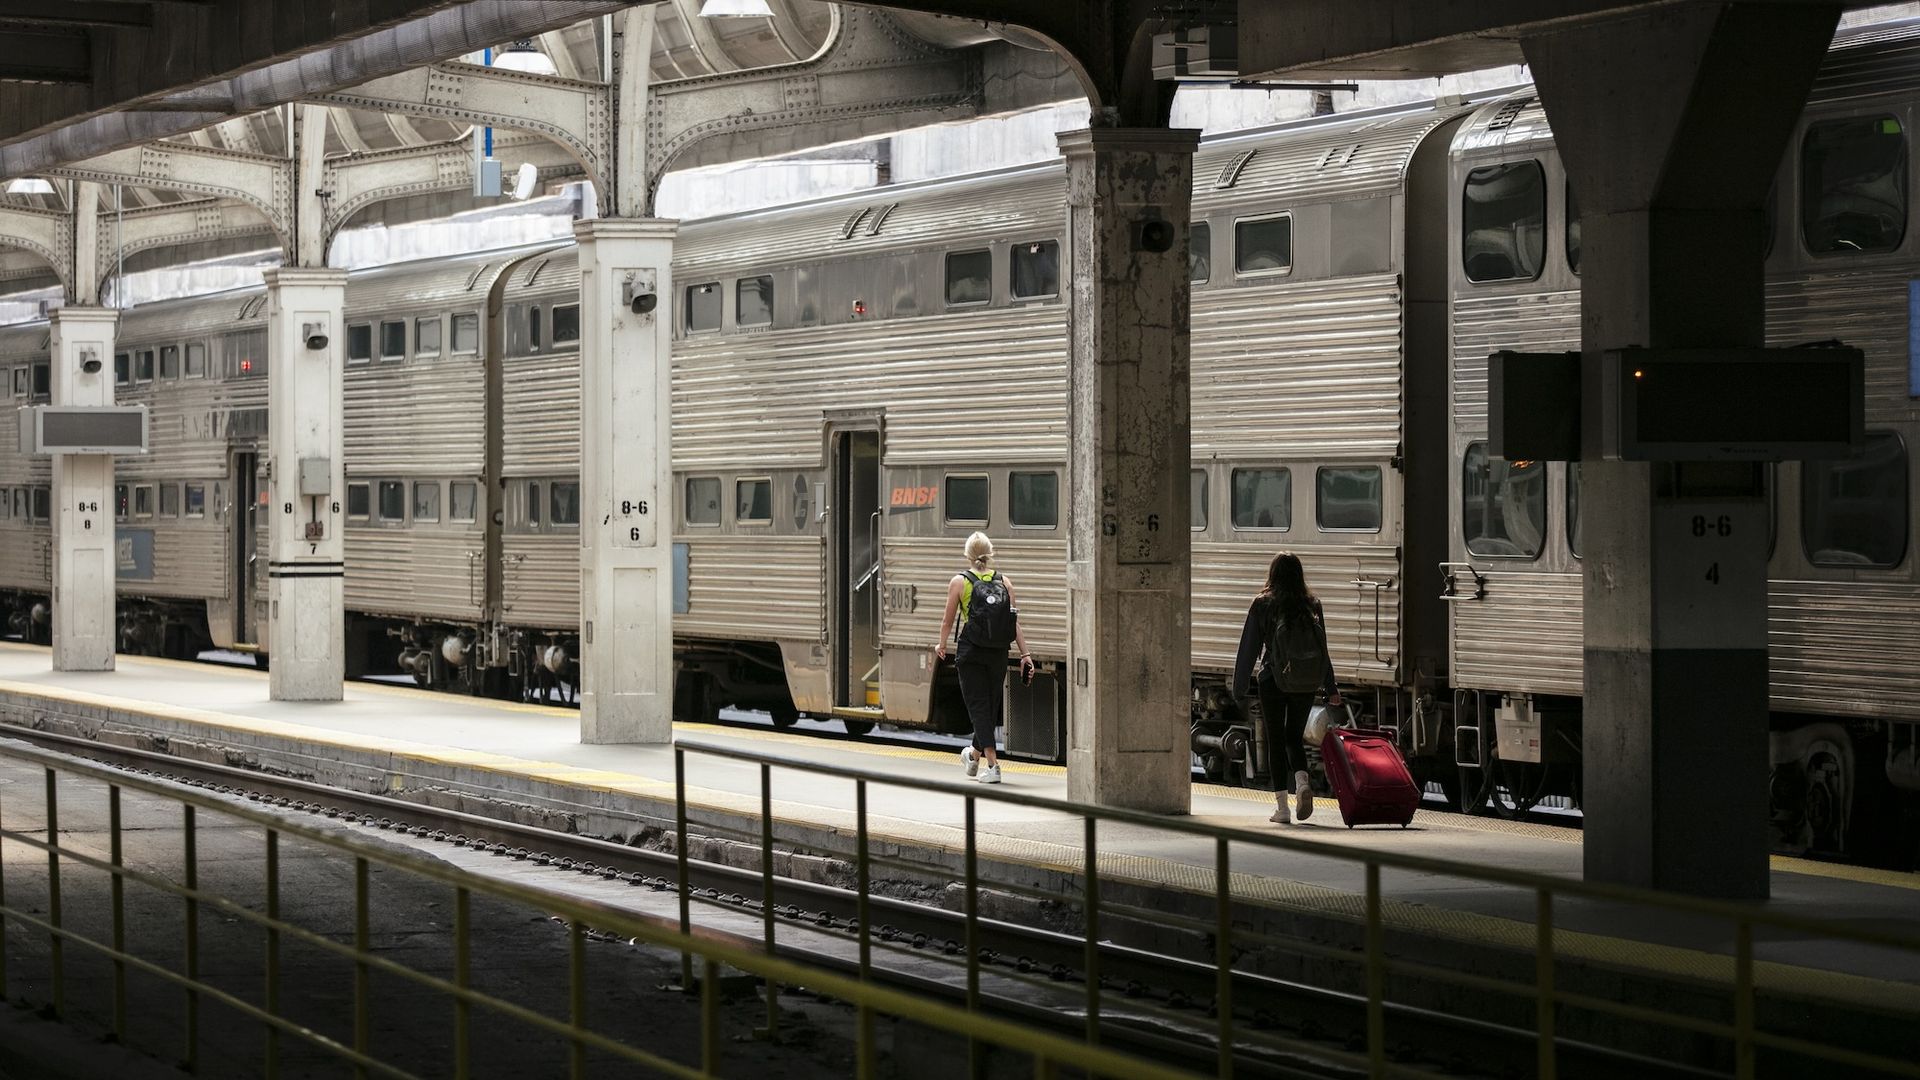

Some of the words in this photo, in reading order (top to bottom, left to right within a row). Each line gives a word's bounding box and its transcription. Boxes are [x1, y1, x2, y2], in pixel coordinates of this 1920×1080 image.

[78, 501, 98, 512] 8-6
[284, 502, 293, 514] 8
[332, 501, 340, 513] 6
[621, 500, 648, 515] 8-6
[1692, 515, 1732, 537] 8-6
[630, 527, 640, 541] 6
[310, 543, 317, 555] 7
[1705, 563, 1719, 585] 4
